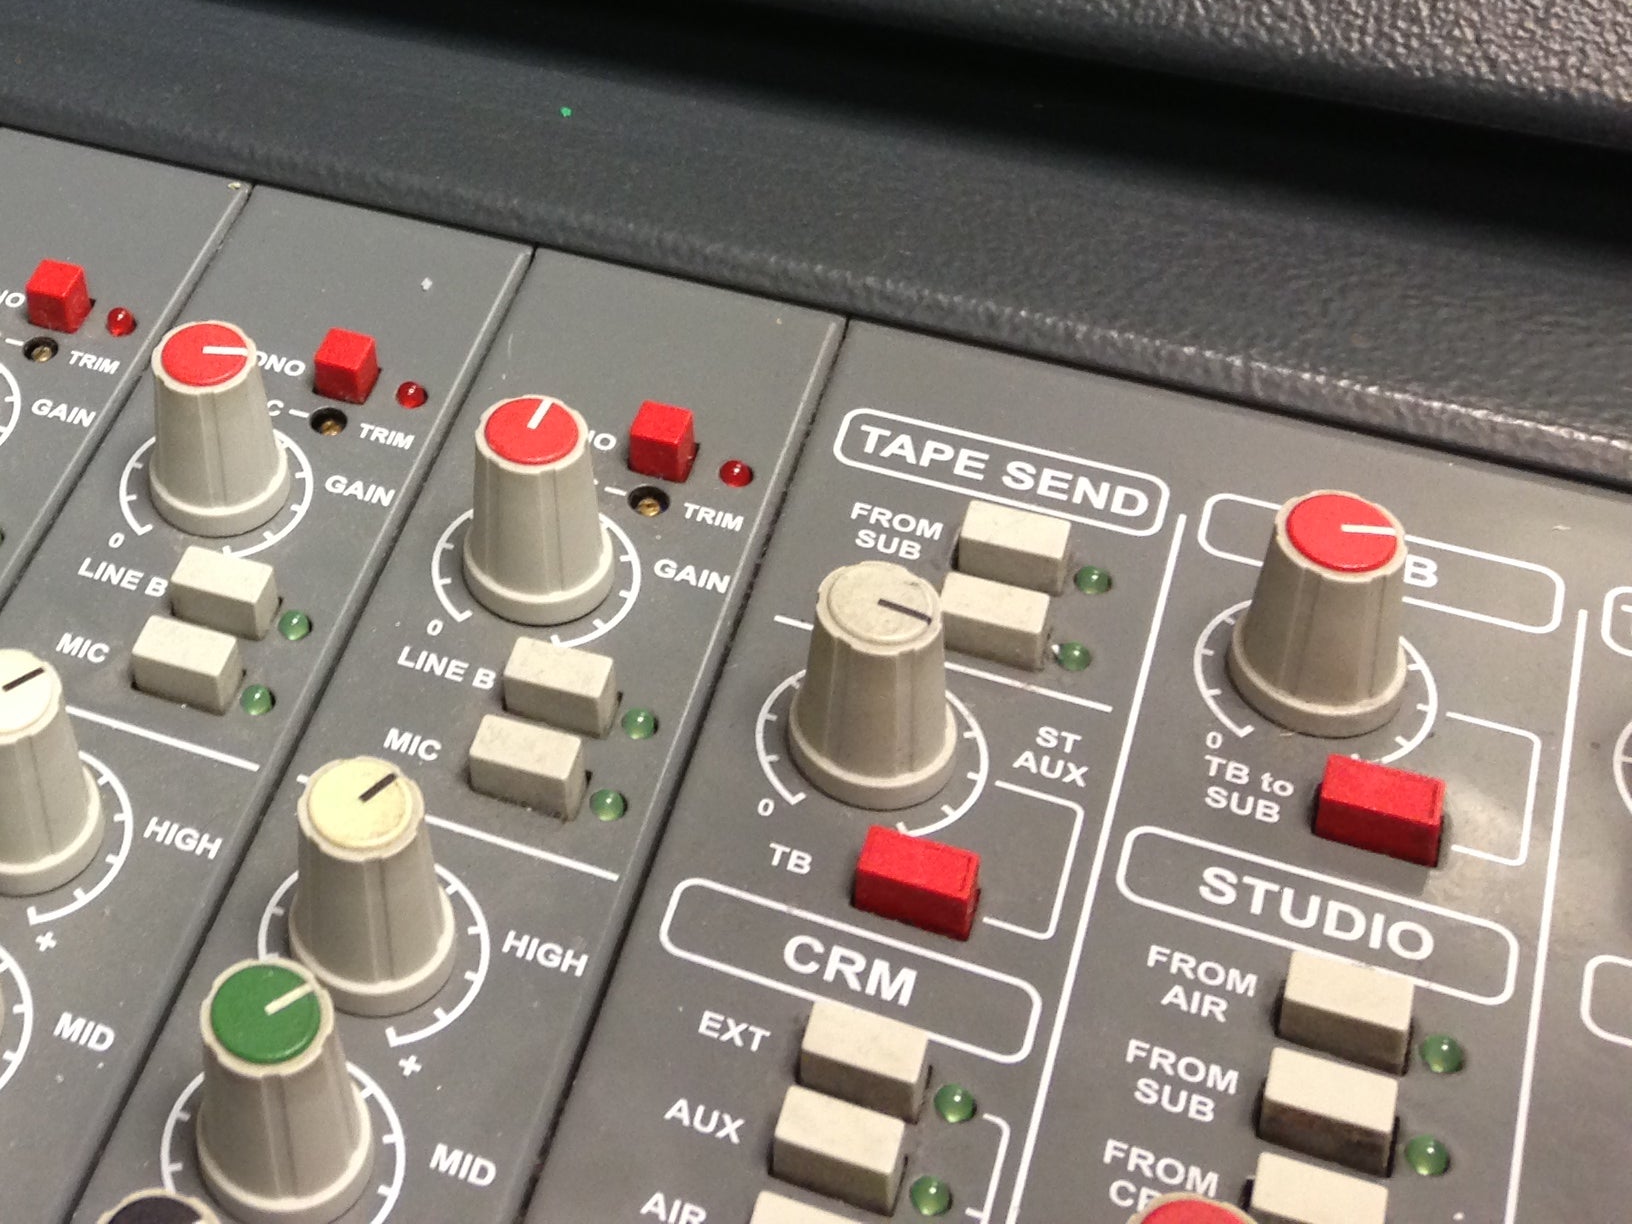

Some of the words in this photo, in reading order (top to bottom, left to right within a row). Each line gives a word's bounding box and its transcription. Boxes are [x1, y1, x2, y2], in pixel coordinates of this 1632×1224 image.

[68, 349, 121, 375] TRIM
[30, 398, 97, 428] GAIN
[359, 422, 416, 451] TRIM
[859, 423, 990, 482] TAPE
[1000, 460, 1150, 518] SEND
[324, 474, 397, 508] GAIN
[683, 502, 745, 533] TRIM
[849, 501, 944, 542] FROM
[107, 532, 125, 549] 0
[855, 529, 923, 561] SUB
[77, 556, 145, 591] LINE
[144, 575, 168, 599] B
[653, 557, 732, 595] GAIN
[426, 618, 444, 637] 0
[55, 632, 111, 664] MIC
[397, 645, 470, 683] LINE
[471, 667, 497, 691] B
[382, 726, 442, 762] MIC
[1034, 725, 1082, 755] ST
[1205, 730, 1224, 751] 0
[1012, 750, 1089, 789] AUX
[1204, 754, 1251, 788] TB
[1260, 770, 1295, 798] to
[756, 797, 776, 817] 0
[1204, 786, 1282, 824] SUB
[142, 815, 224, 861] HIGH
[768, 841, 813, 876] TB
[1197, 864, 1436, 962] STUDIO
[501, 929, 589, 979] HIGH
[782, 934, 918, 1008] CRM
[1146, 943, 1259, 998] FROM
[1160, 983, 1230, 1023] AIR
[52, 1011, 116, 1053] MID
[697, 1009, 772, 1053] EXT
[1124, 1038, 1240, 1096] FROM
[1133, 1077, 1217, 1124] SUB
[663, 1097, 746, 1145] AUX
[429, 1142, 498, 1188] MID
[1102, 1138, 1220, 1198] FROM
